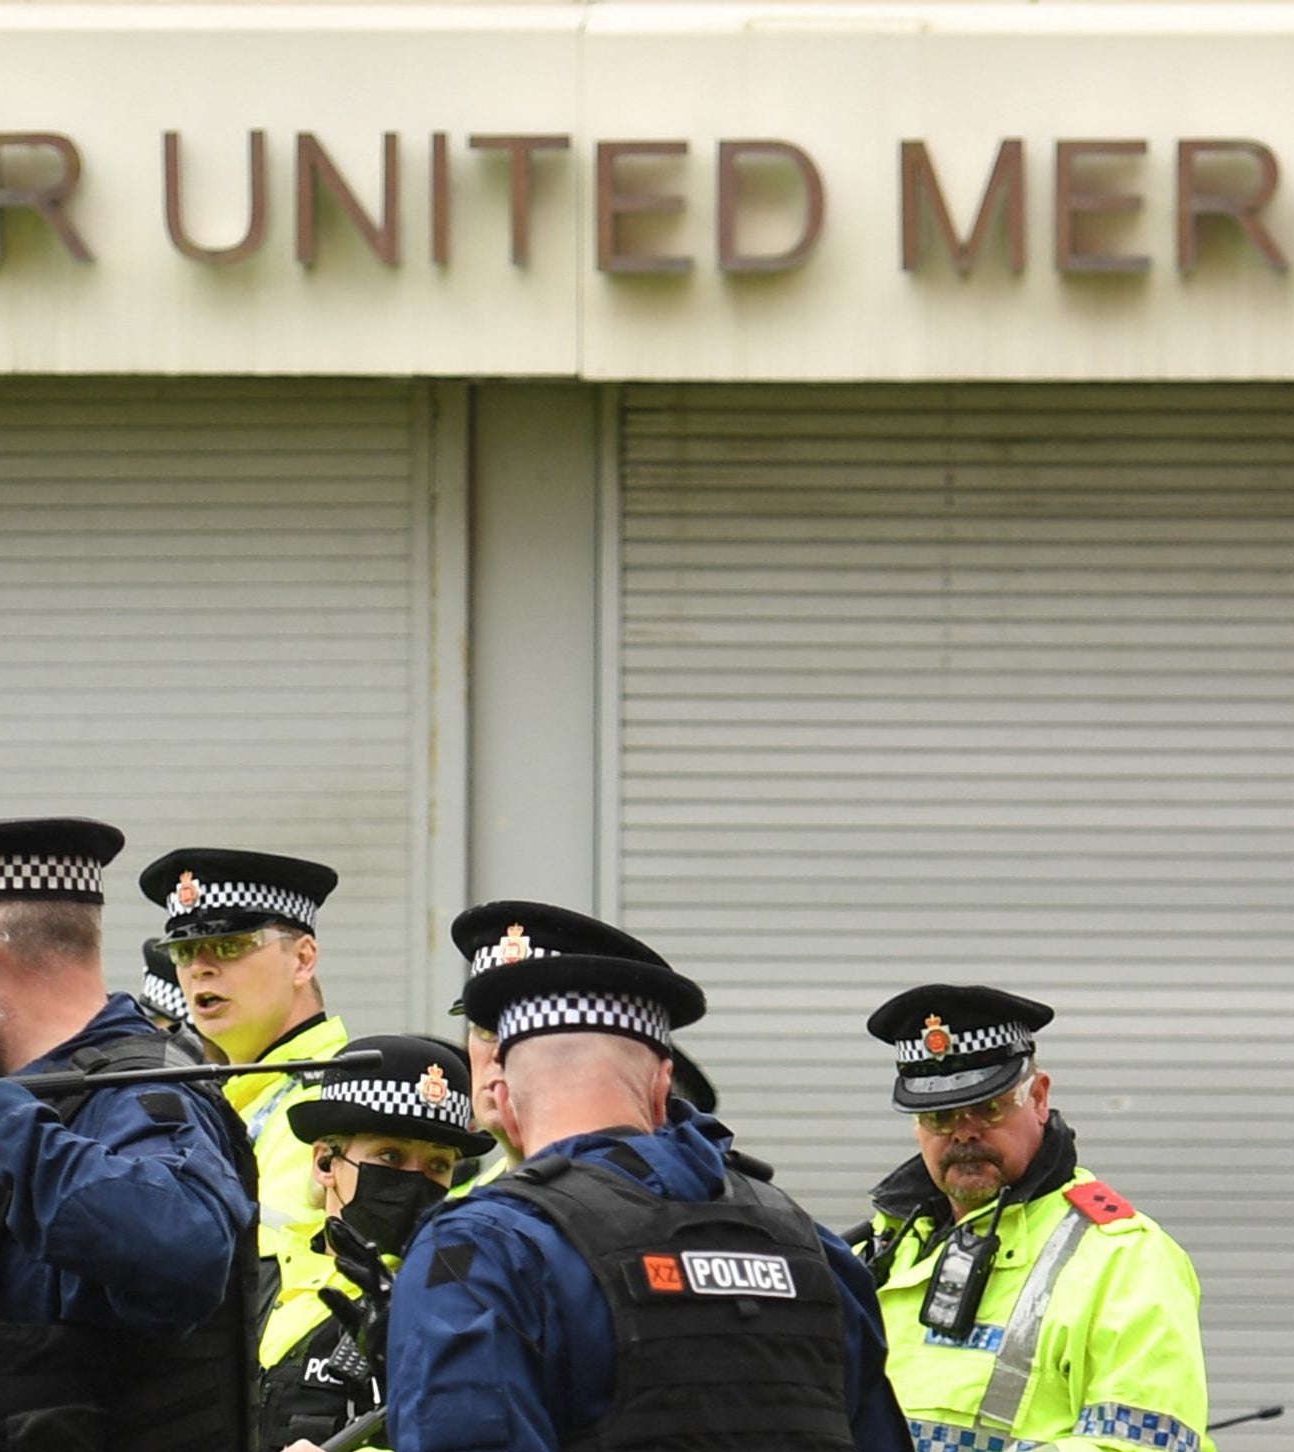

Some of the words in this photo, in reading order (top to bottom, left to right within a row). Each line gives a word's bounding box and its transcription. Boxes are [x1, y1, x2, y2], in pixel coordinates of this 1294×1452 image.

[162, 129, 826, 275] UNITED
[649, 1262, 680, 1284] XZ
[692, 1257, 788, 1291] POLICE
